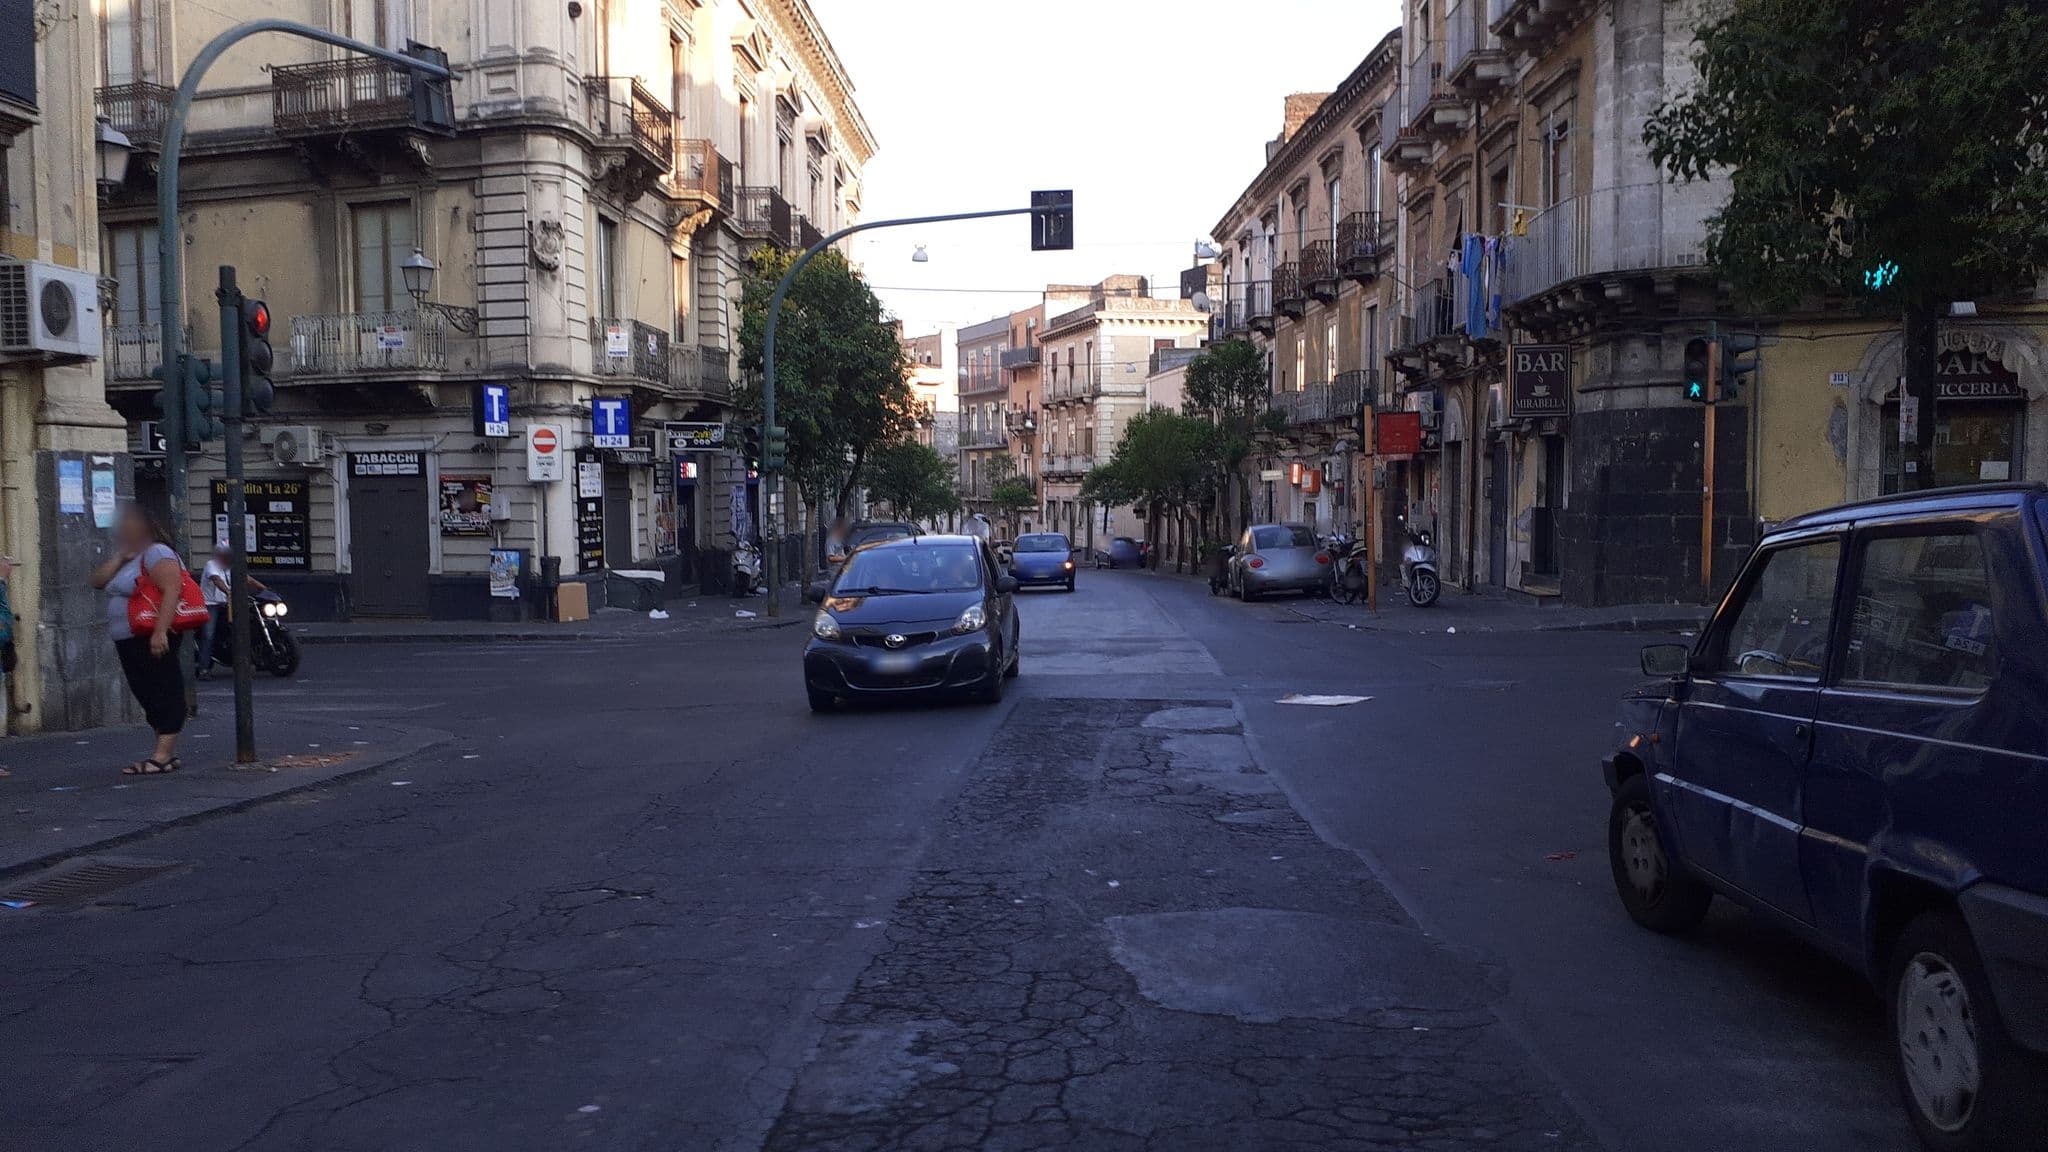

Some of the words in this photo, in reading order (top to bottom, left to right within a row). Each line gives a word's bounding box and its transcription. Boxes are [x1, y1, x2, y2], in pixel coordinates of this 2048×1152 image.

[1516, 352, 1566, 373] BAR
[1937, 352, 1992, 375] AR
[1937, 383, 2010, 396] ICCERIA
[487, 387, 504, 422] T
[1516, 397, 1566, 409] MIRABELLA
[599, 401, 622, 435] T
[489, 424, 495, 433] H
[497, 424, 505, 434] 24
[600, 436, 608, 446] H
[610, 436, 623, 446] 24
[355, 452, 419, 464] TABACCHI
[216, 482, 263, 495] Ridita
